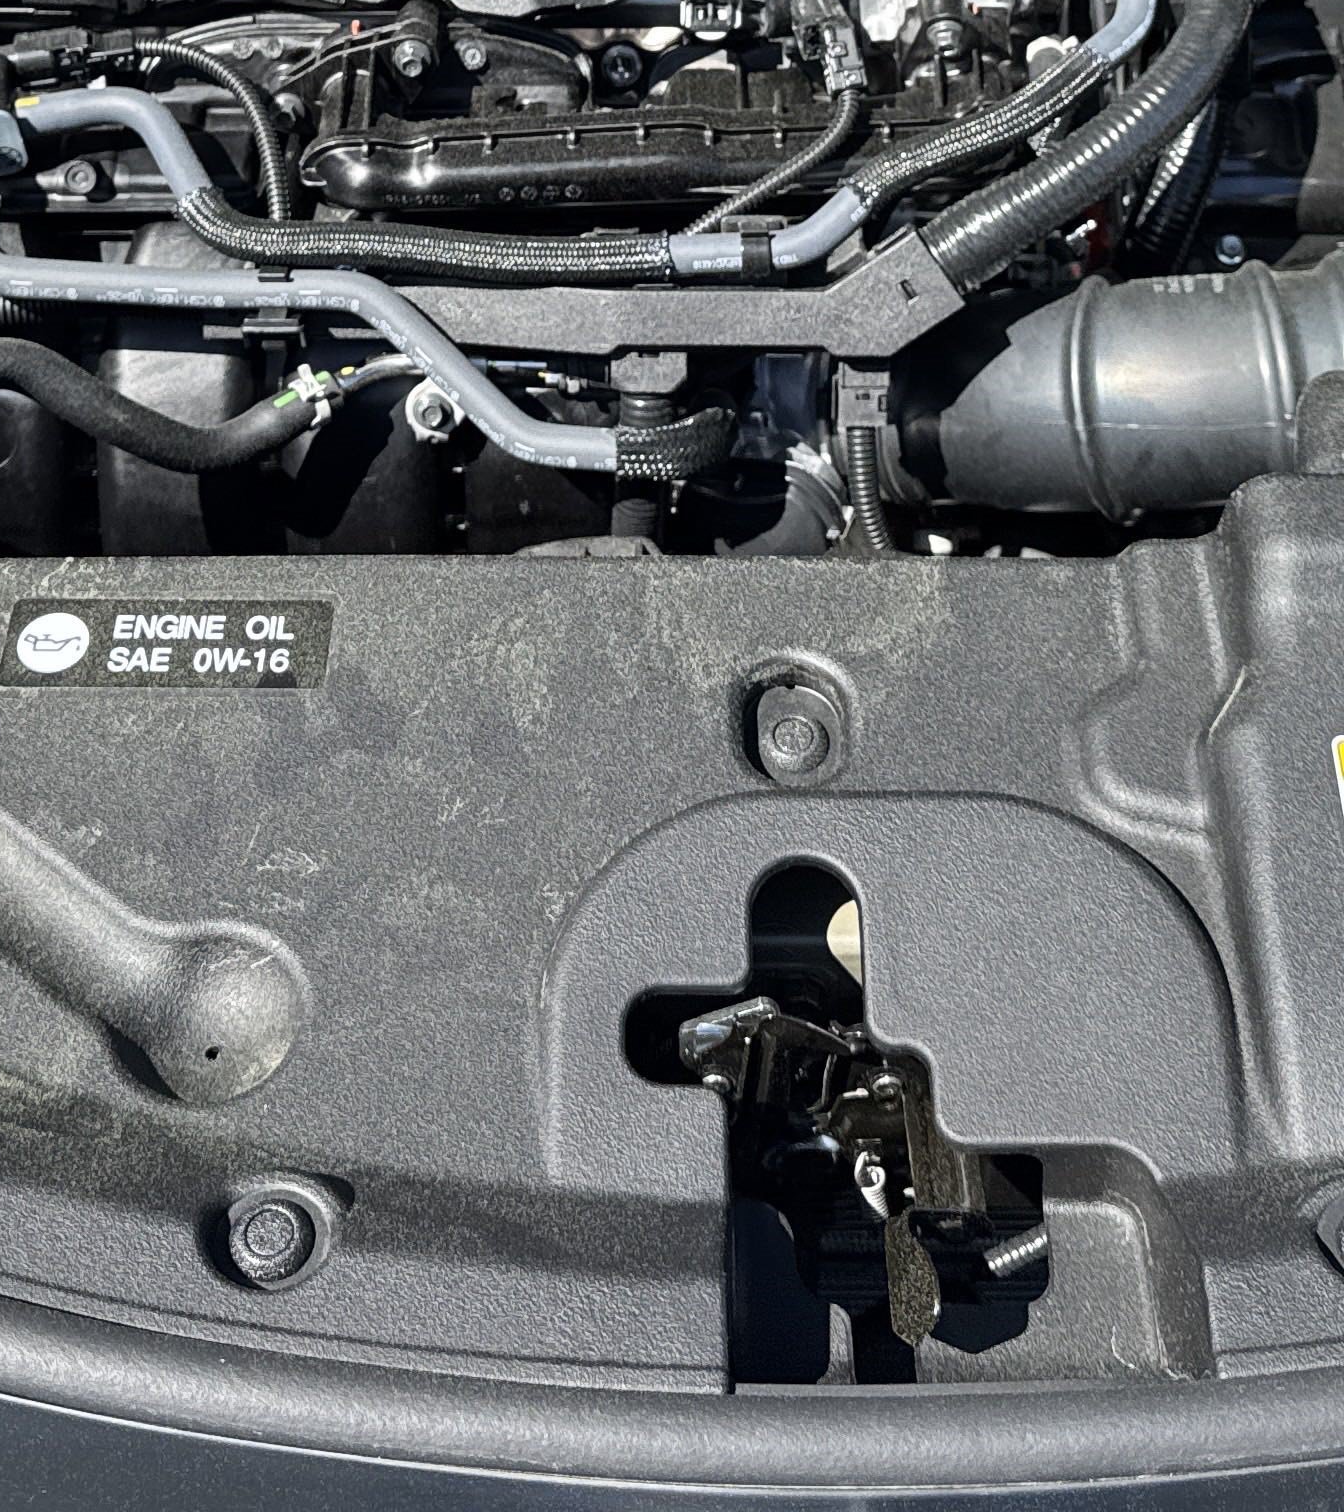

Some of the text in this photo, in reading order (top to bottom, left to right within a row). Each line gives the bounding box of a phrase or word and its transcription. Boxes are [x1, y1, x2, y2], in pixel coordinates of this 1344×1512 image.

[112, 614, 295, 641] ENGINE OIL
[106, 646, 291, 674] SAE 0W-16
